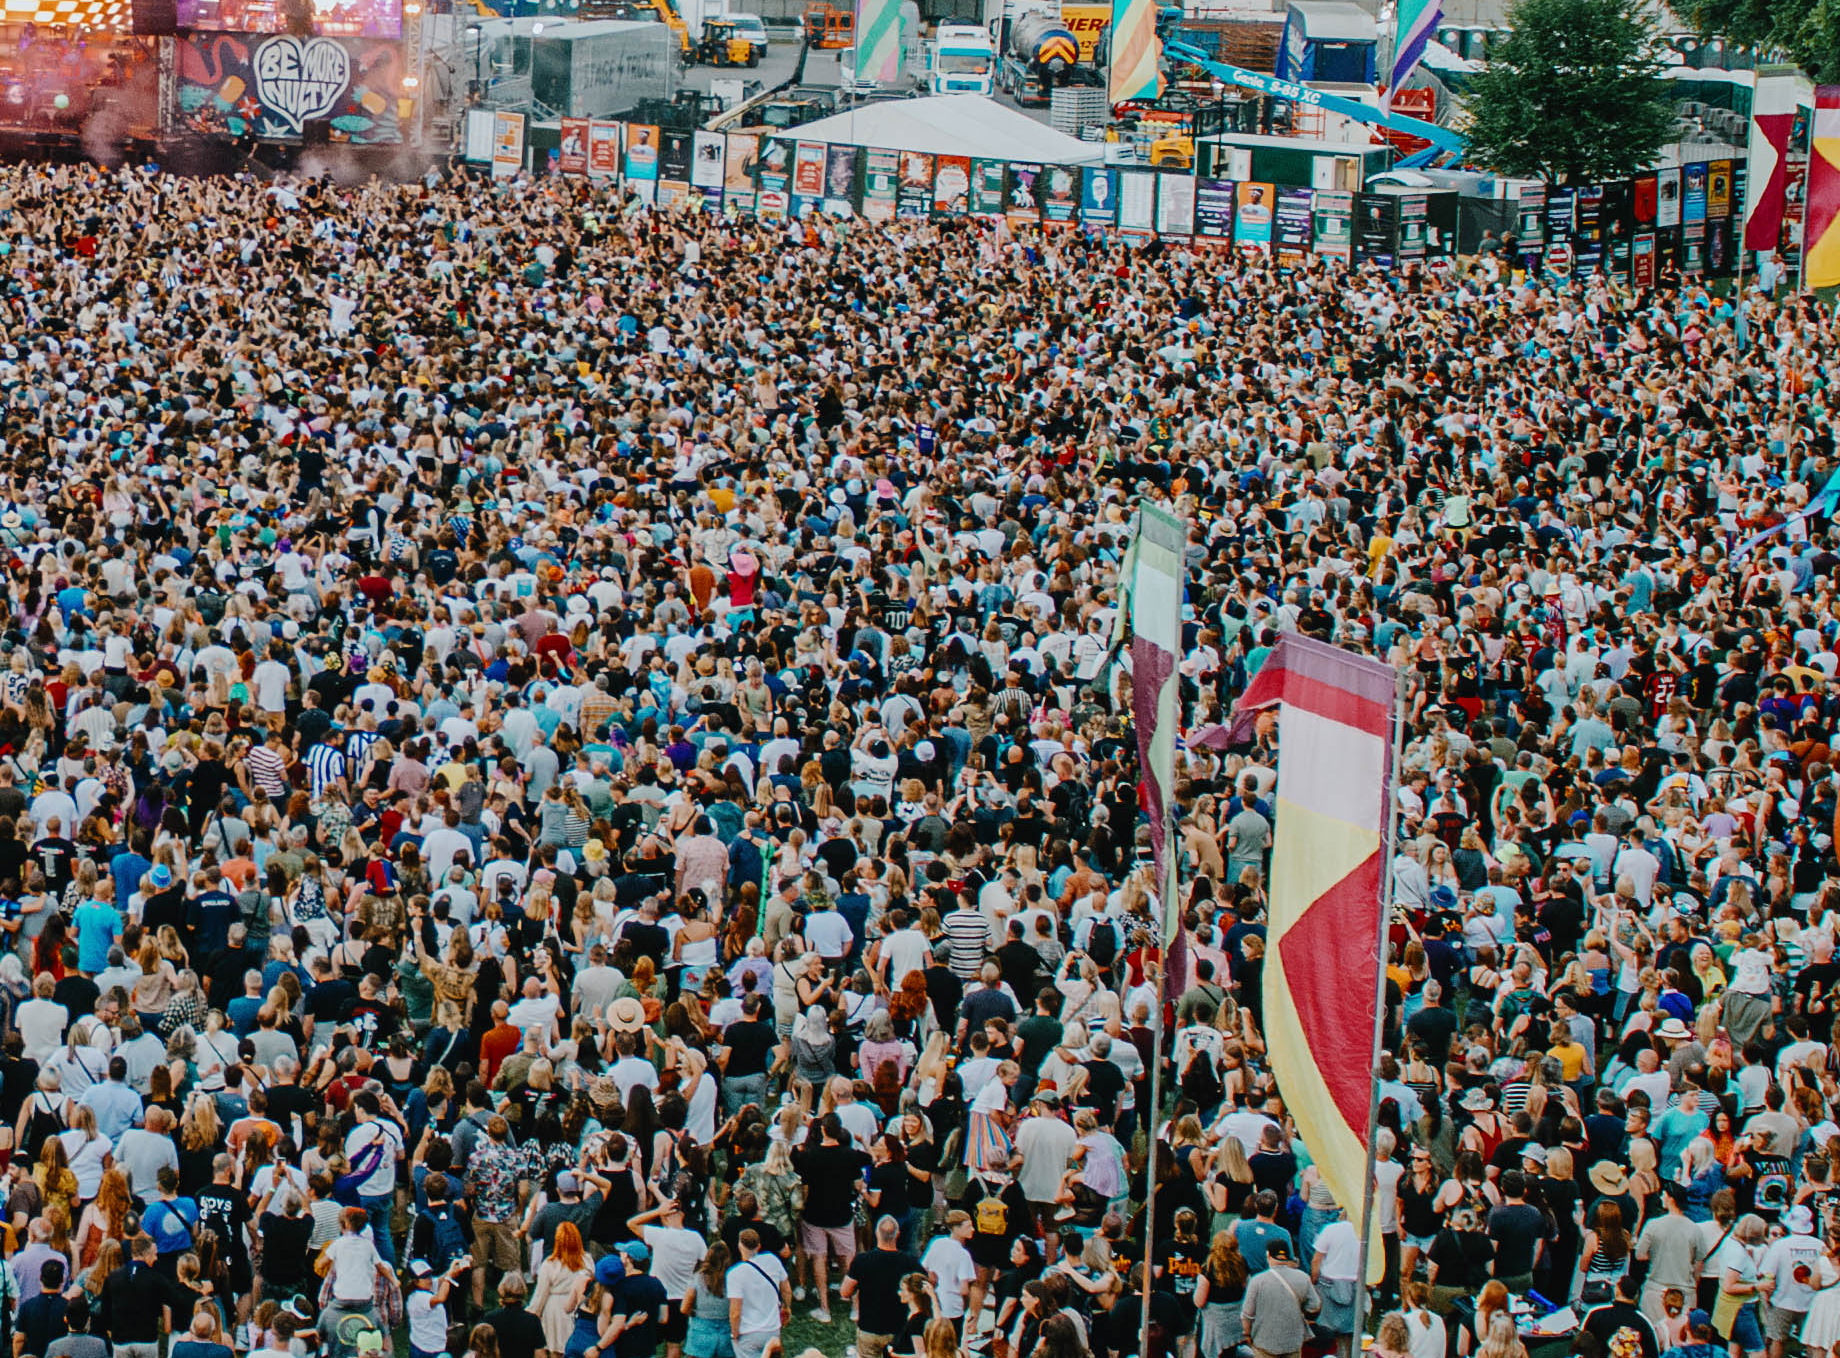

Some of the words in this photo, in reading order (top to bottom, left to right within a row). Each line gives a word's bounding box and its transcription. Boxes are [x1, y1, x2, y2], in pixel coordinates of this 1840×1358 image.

[261, 41, 299, 79] BE
[302, 42, 346, 82] MORE
[262, 80, 339, 120] NULTY
